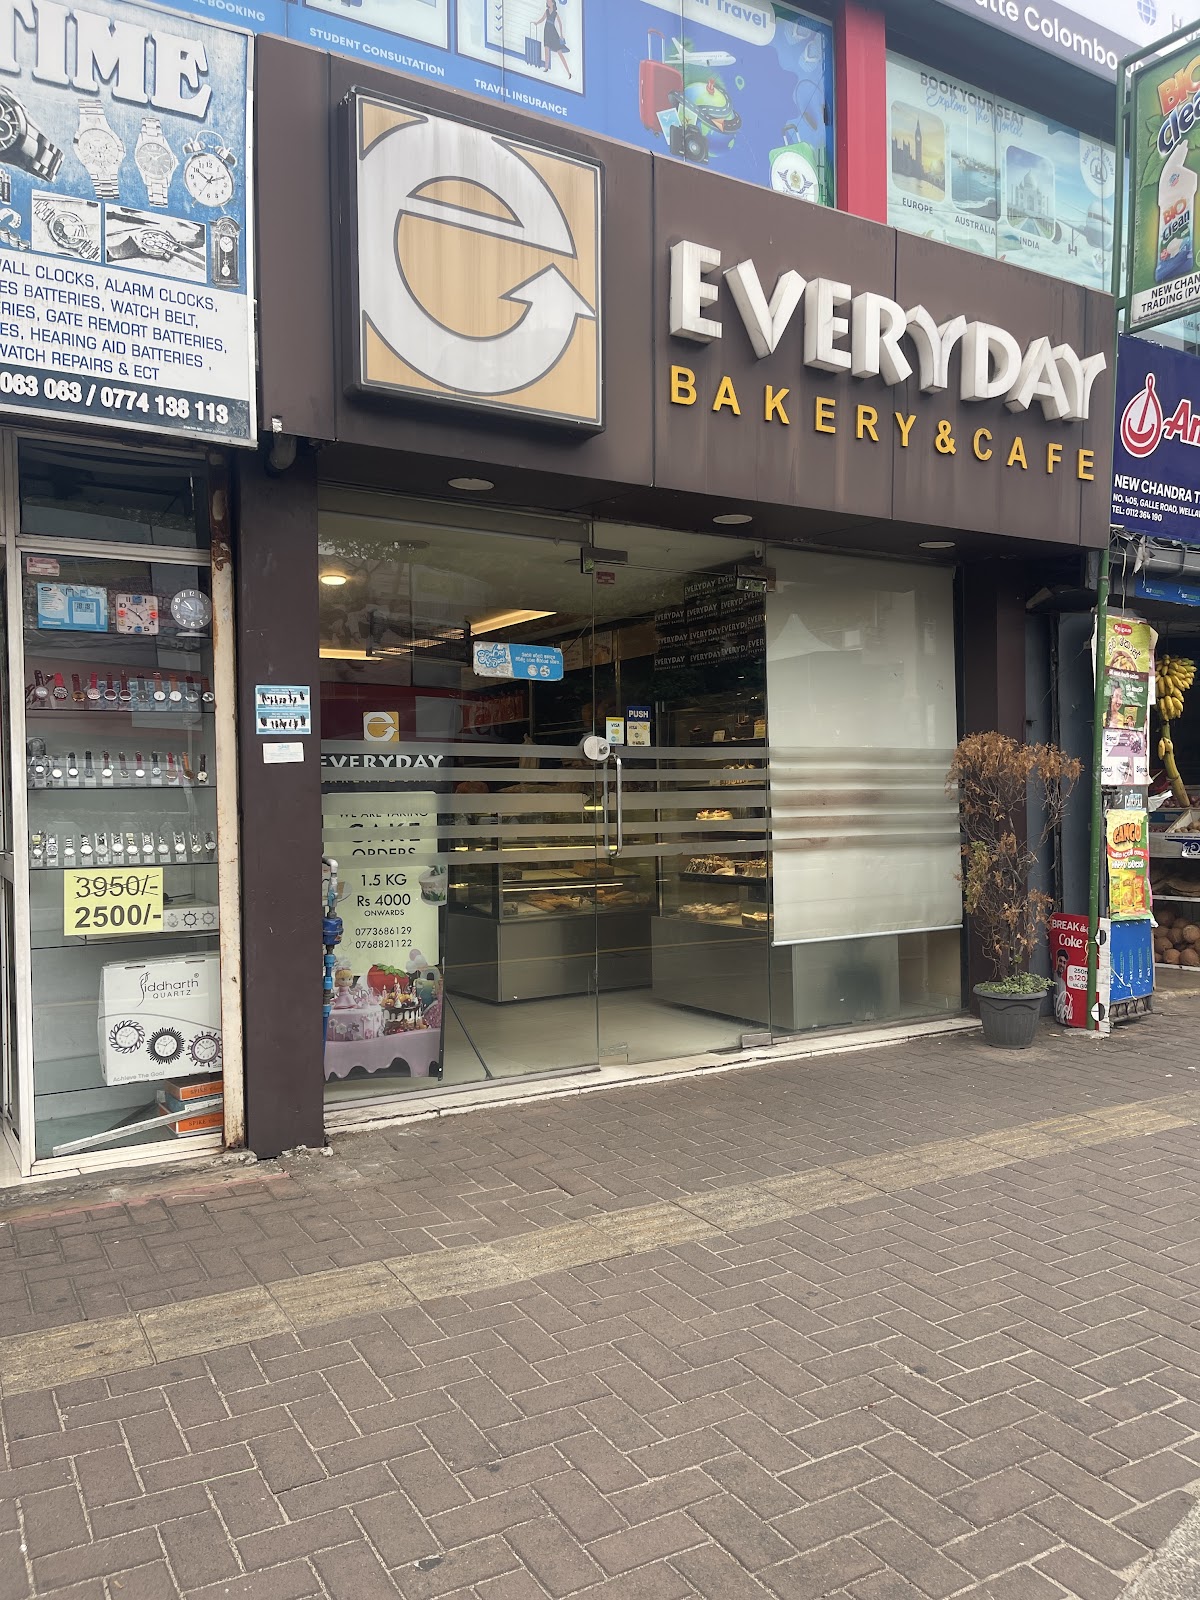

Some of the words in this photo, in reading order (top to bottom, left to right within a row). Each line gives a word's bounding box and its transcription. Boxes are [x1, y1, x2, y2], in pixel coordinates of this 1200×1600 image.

[208, 0, 266, 22] BOOKING
[717, 0, 768, 29] Travel
[1024, 6, 1118, 70] Colombo
[309, 27, 360, 50] STUDENT
[362, 43, 446, 77] CONSULTATION
[474, 79, 511, 98] TRAVEL
[512, 90, 568, 117] INSURANCE
[920, 71, 957, 99] BOOK
[960, 88, 994, 113] YOUR
[996, 104, 1025, 126] SEAT
[902, 197, 934, 215] EUROPE
[955, 215, 996, 236] AUSTRALIA
[1019, 236, 1041, 250] INDIA
[0, 256, 30, 276] ALL
[35, 265, 99, 290] CLOCKS,
[104, 278, 154, 299] ALARM
[159, 287, 218, 313] CLOCKS,
[1151, 283, 1174, 299] NEW
[24, 285, 105, 312] BATTERIES,
[110, 299, 159, 320] WATCH
[164, 309, 199, 329] BELT,
[1141, 291, 1183, 313] TRADING
[46, 309, 83, 327] GATE
[88, 317, 148, 338] REMORT
[152, 327, 228, 354] BATTERIES,
[669, 239, 1107, 422] EVERYDAY
[30, 327, 97, 350] HEARING
[102, 339, 126, 355] AID
[131, 344, 203, 368] BATTERIES
[51, 351, 113, 374] REPAIRS
[118, 362, 130, 376] &
[133, 365, 160, 381] ECT
[0, 371, 39, 397] 063
[43, 377, 83, 404] 063
[86, 383, 97, 407] /
[100, 386, 150, 413] 0774
[154, 394, 190, 419] 138
[194, 400, 229, 424] 113
[670, 364, 917, 447] BAKERY
[934, 419, 957, 455] &
[973, 428, 1095, 481] CAFE
[1114, 473, 1140, 492] NEW
[1141, 480, 1192, 502] CHANDRA
[1112, 504, 1125, 515] TEL:
[1125, 507, 1138, 518] 0112
[1139, 509, 1151, 520] 364
[1151, 512, 1163, 522] 190
[1113, 493, 1124, 503] NO.
[1125, 495, 1139, 507] 405,
[1139, 499, 1159, 510] GALLE
[1160, 502, 1178, 515] ROAD,
[684, 579, 716, 595] EVERYDAY
[655, 610, 685, 622] EVERYDAY
[686, 603, 718, 618] EVERYDAY
[689, 627, 722, 640] EVERYDAY
[654, 656, 686, 667] EVERYDAY
[690, 650, 721, 663] EVERYDAY
[628, 709, 649, 718] PUSH
[75, 876, 159, 899] 3950/-
[361, 874, 381, 886] 1.5
[385, 873, 407, 886] KG
[356, 895, 371, 907] Rs
[374, 894, 411, 906] 4000
[75, 904, 162, 928] 2500/-
[364, 909, 405, 917] ONWARDS
[355, 927, 412, 936] 0773686129
[1052, 920, 1080, 932] BREAK
[355, 939, 412, 949] 0768821122
[1058, 933, 1083, 949] Coke
[152, 989, 192, 999] QUARTZ
[113, 1074, 137, 1083] Achieve
[150, 1070, 165, 1078] Goal
